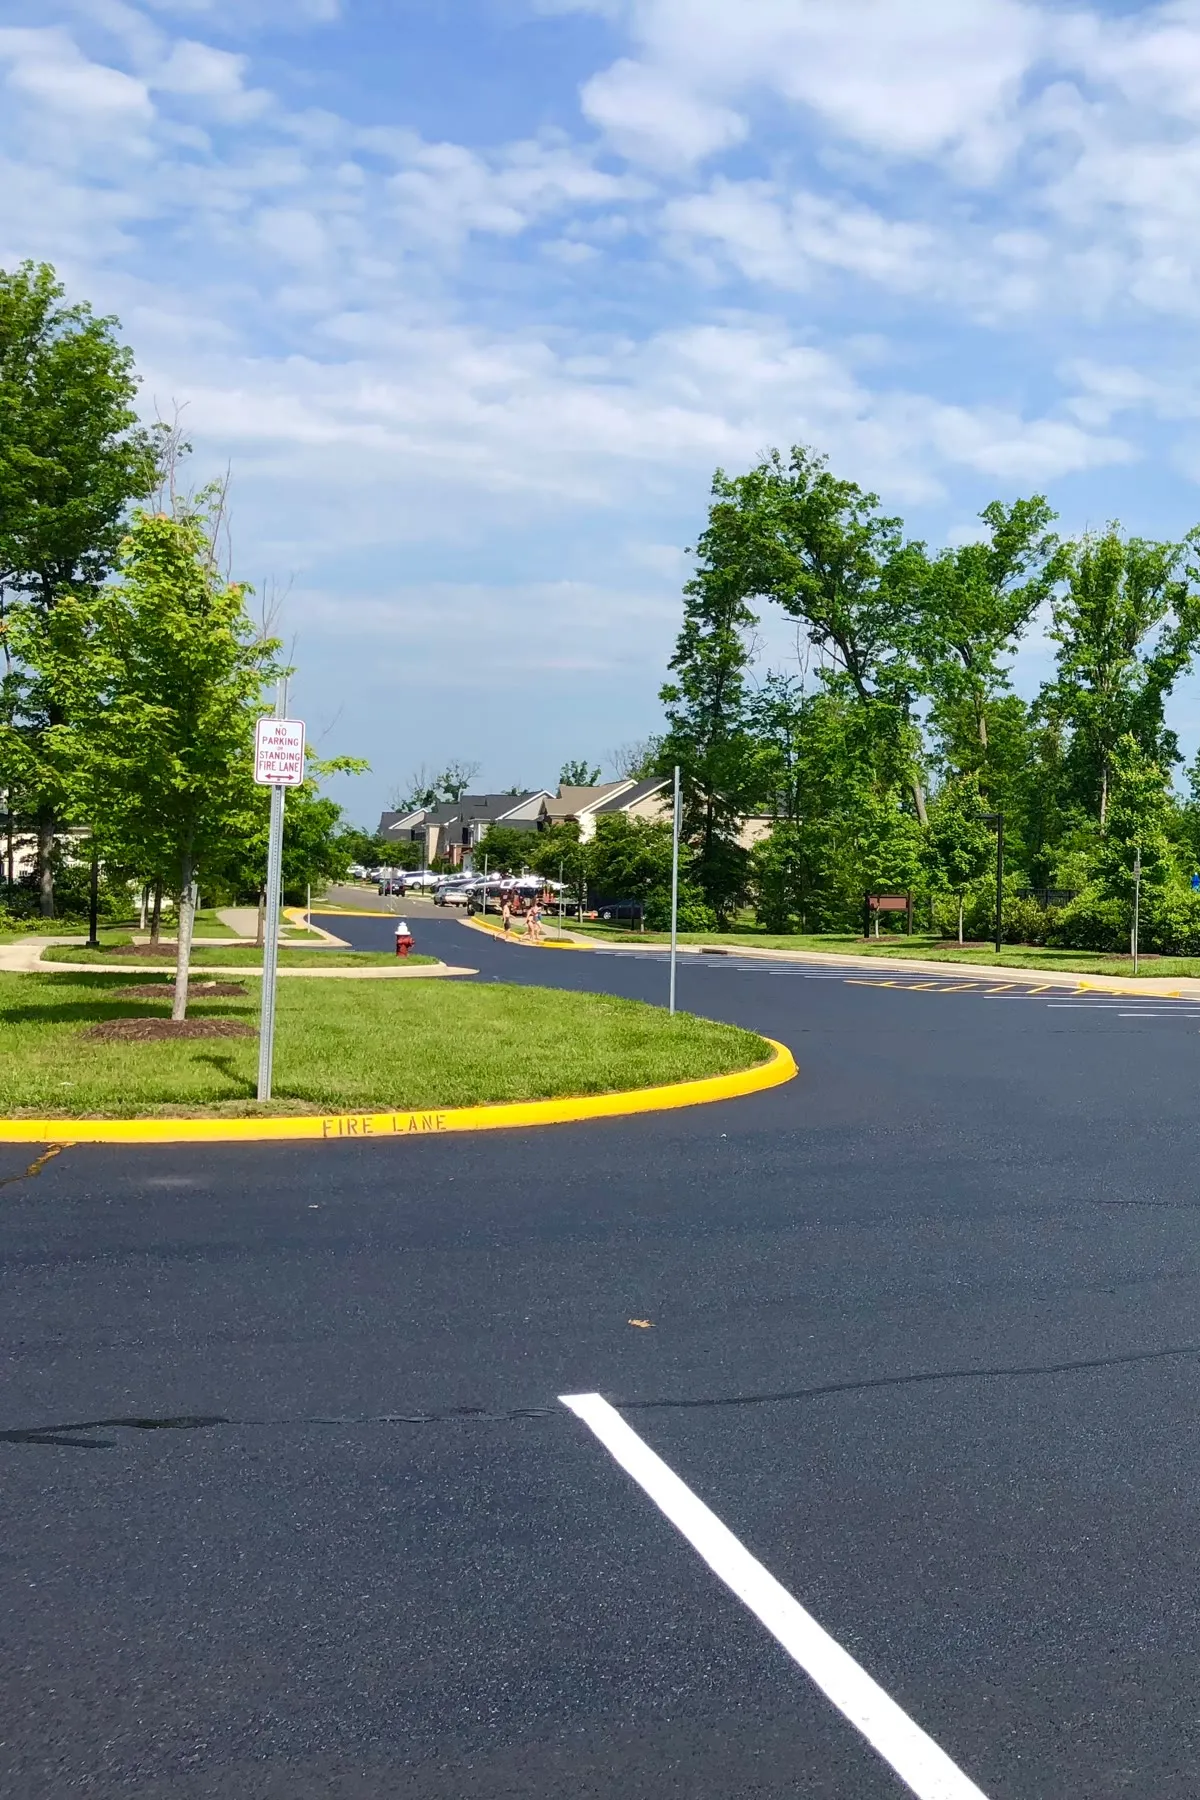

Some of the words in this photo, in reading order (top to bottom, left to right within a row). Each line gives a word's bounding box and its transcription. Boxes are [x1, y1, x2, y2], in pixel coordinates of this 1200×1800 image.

[275, 727, 287, 736] NO
[262, 736, 299, 747] PARKING
[259, 750, 301, 761] STANDING
[259, 760, 277, 771] FIRE
[279, 762, 300, 773] LANE
[322, 1117, 374, 1138] FIRE
[392, 1114, 447, 1132] LANE
